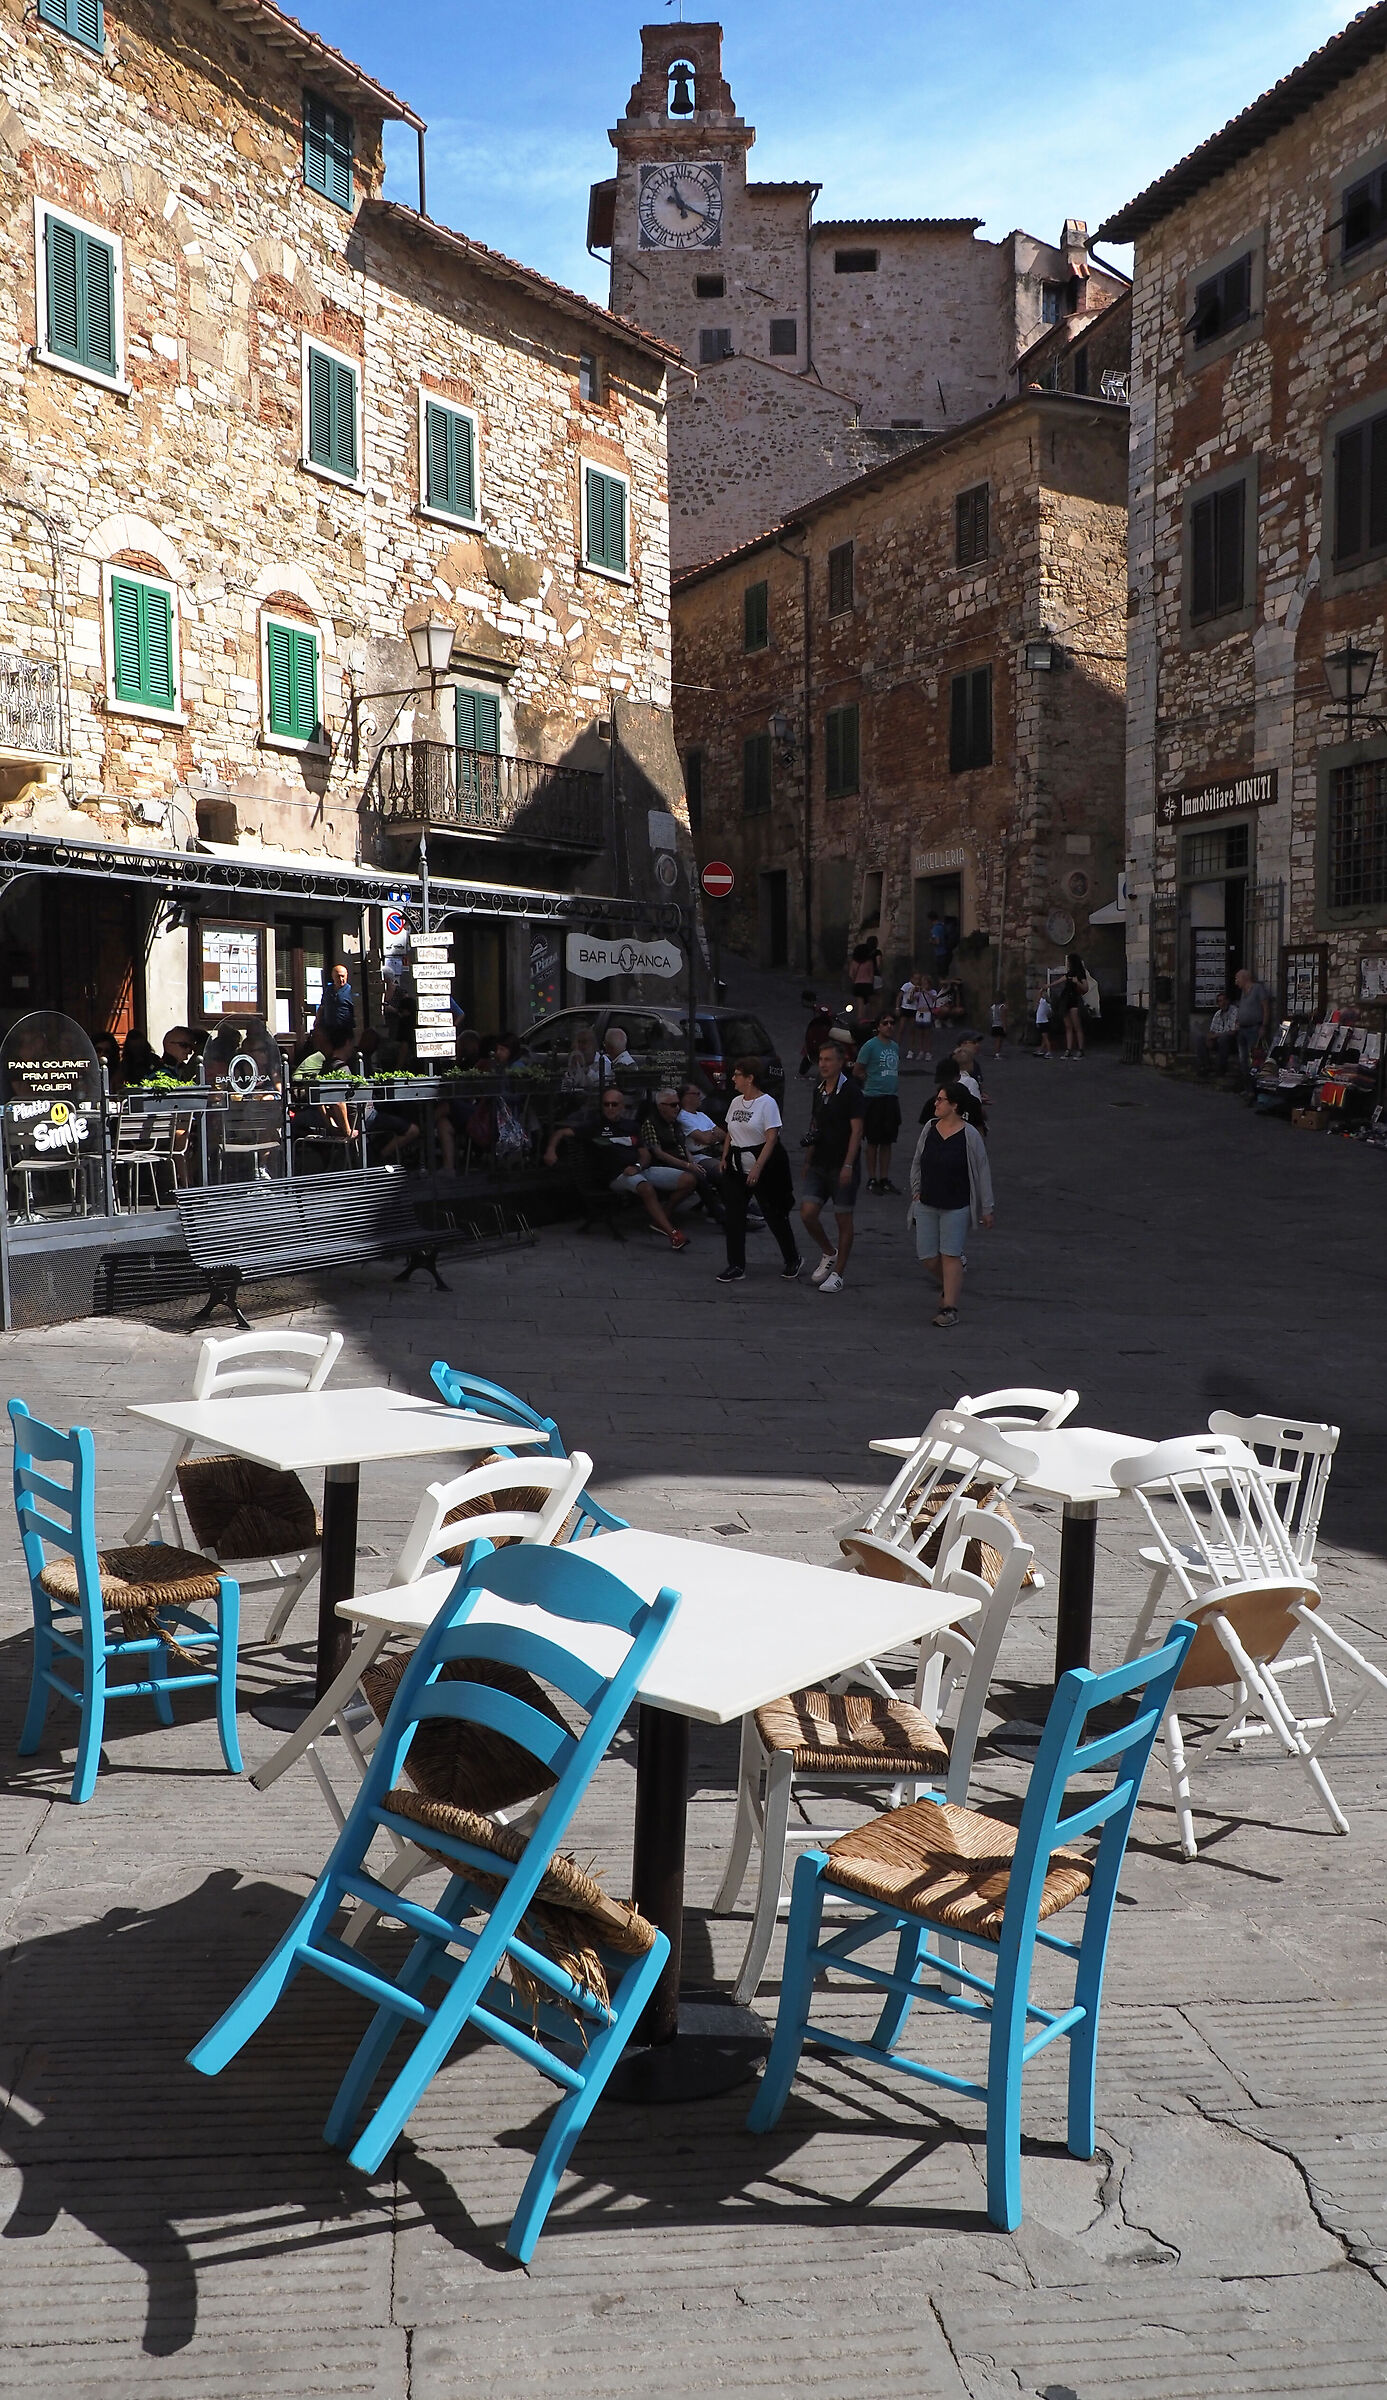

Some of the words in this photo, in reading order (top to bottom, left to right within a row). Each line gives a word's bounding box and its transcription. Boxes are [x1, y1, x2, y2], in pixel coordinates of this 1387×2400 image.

[1181, 787, 1234, 816] Immobiliare
[1235, 775, 1271, 805] MINUTI
[916, 848, 964, 870] MACELLERIA
[580, 950, 606, 963] BAR
[610, 952, 626, 965] LA
[630, 954, 671, 968] PANCA
[42, 1060, 90, 1068] GOURMET
[30, 1084, 72, 1092] TAGLIERI
[12, 1100, 50, 1122] Piatto
[33, 1112, 89, 1152] Smile
